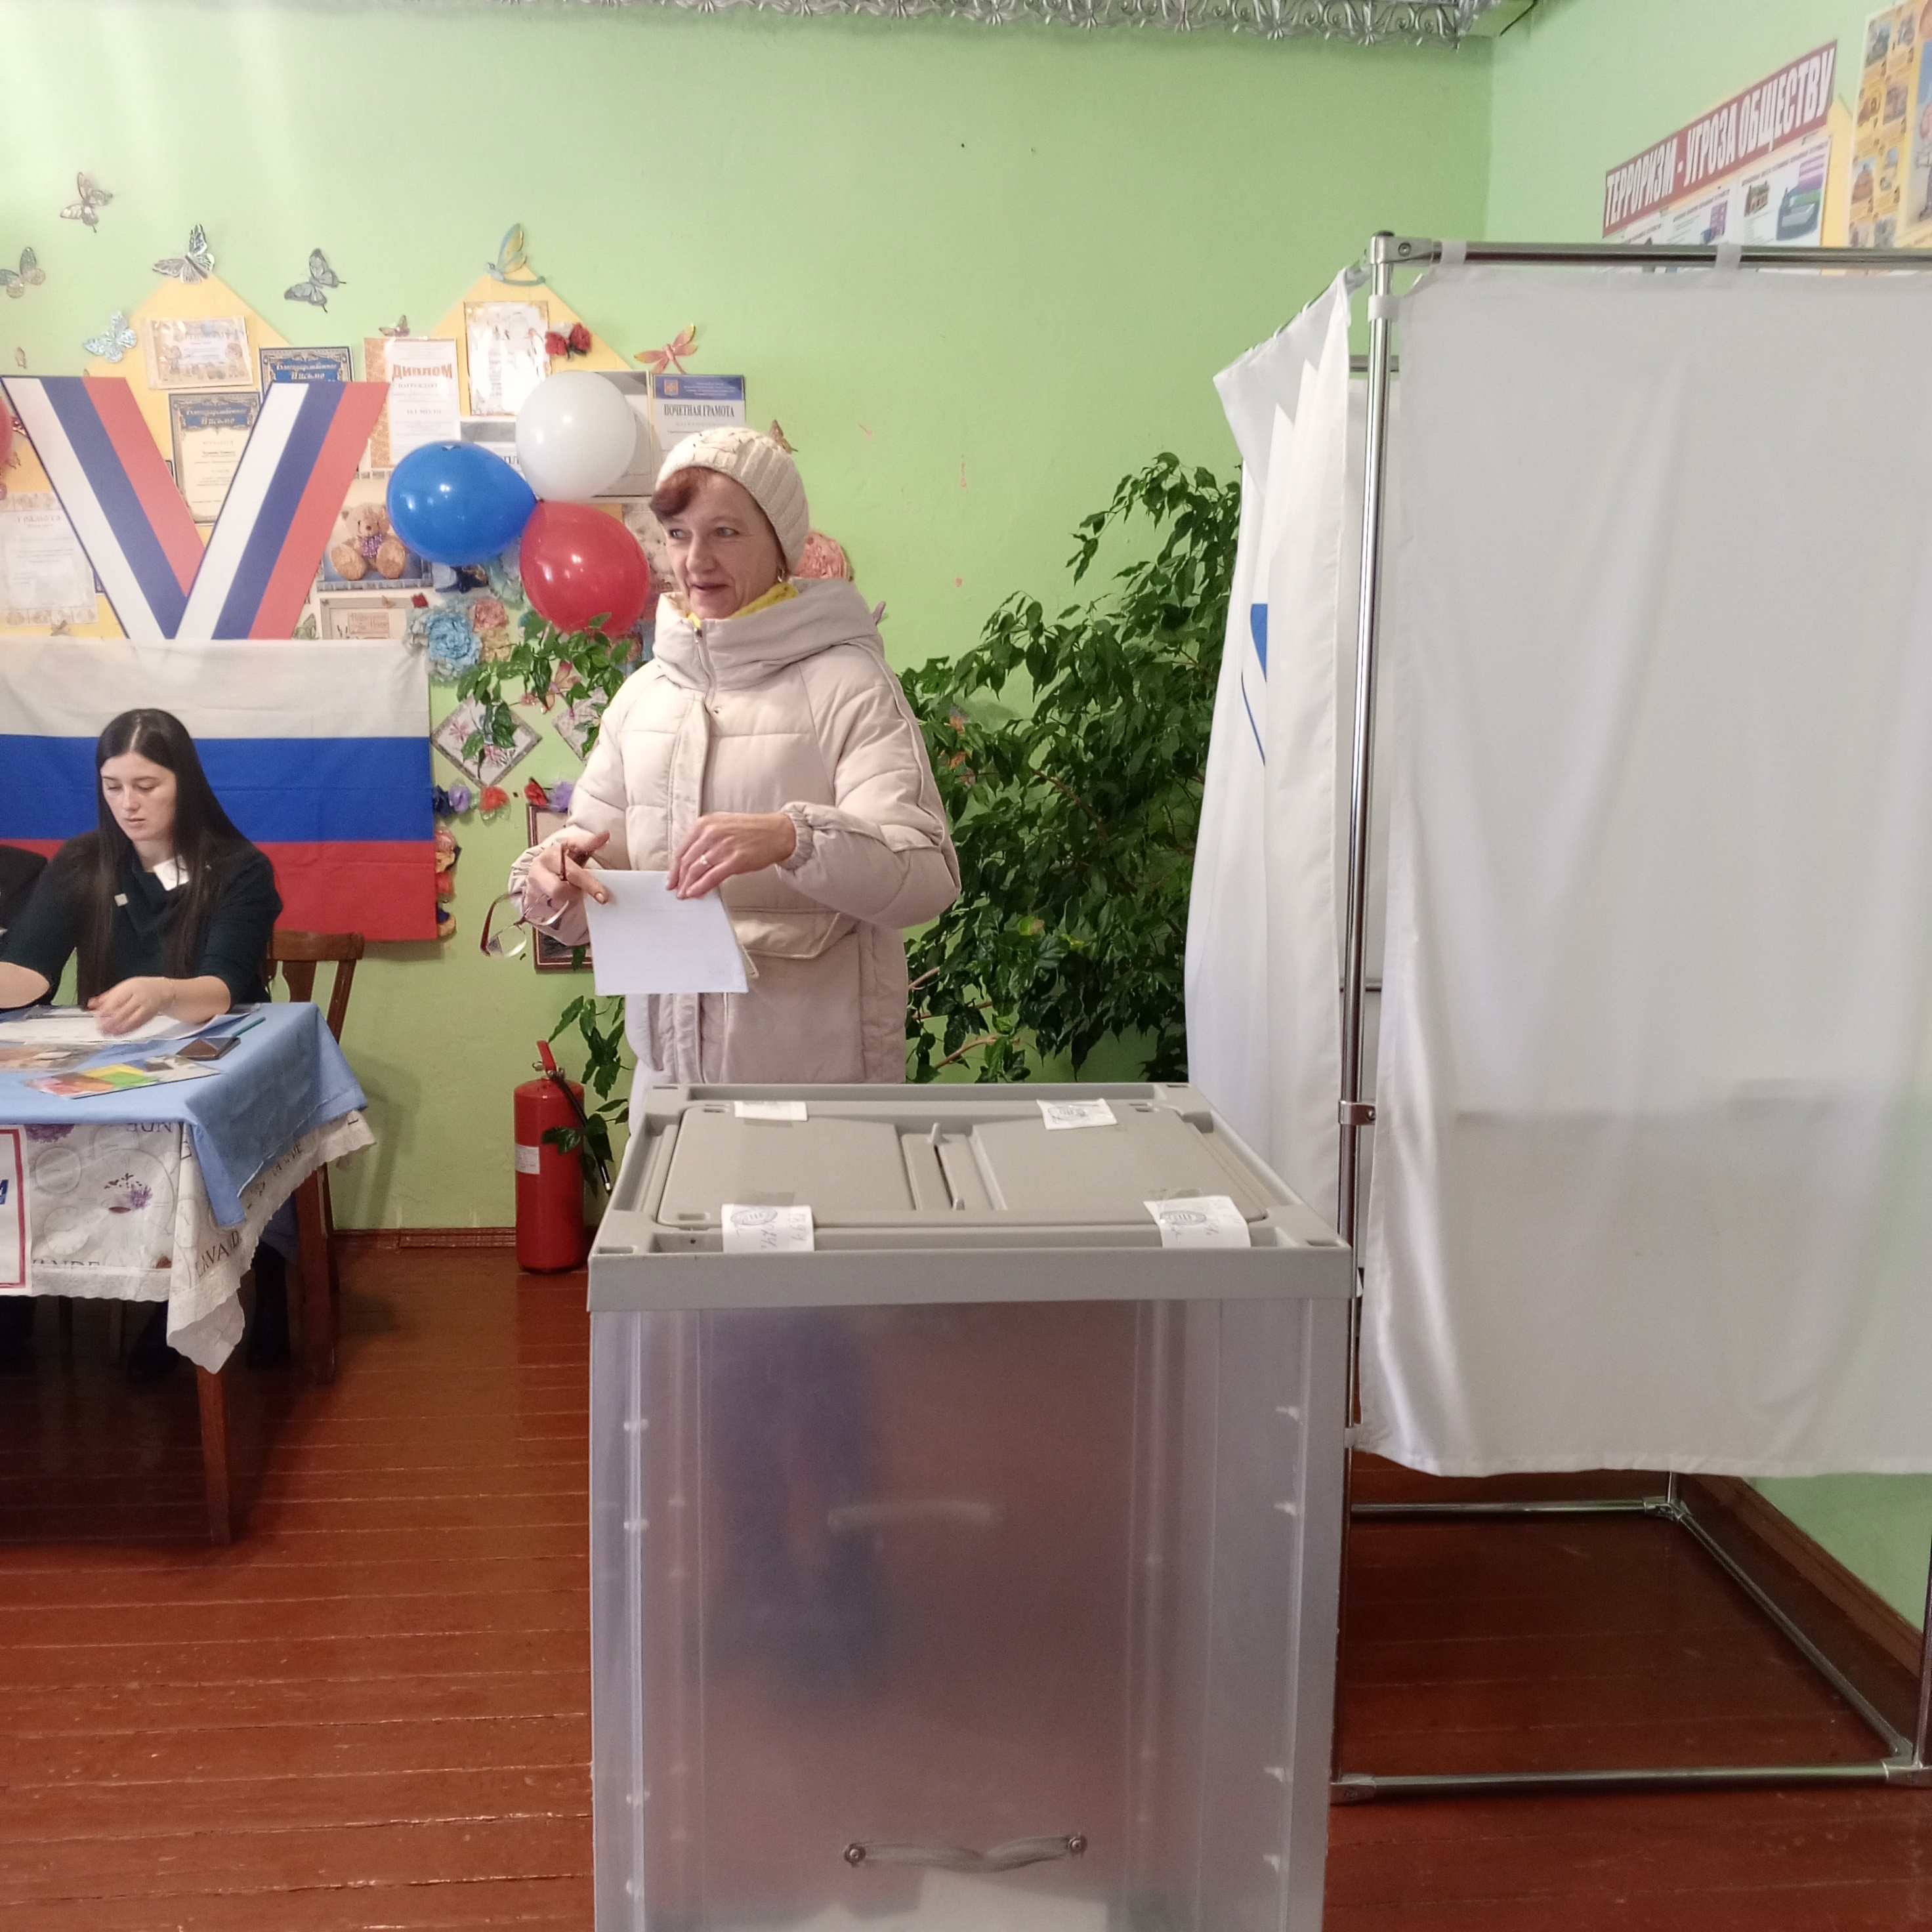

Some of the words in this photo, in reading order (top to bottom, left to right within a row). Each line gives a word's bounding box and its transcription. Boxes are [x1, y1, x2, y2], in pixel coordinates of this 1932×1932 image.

[1605, 137, 1678, 228] ТЕРРОРИЗМ
[1684, 102, 1738, 188] УГРОЗА
[1738, 47, 1836, 159] ОБЩЕСТВУ
[392, 363, 452, 381] ДИПЛОМ
[664, 404, 702, 417] ПОЧЕТНАЯ
[703, 404, 735, 417] ГРАМОТА
